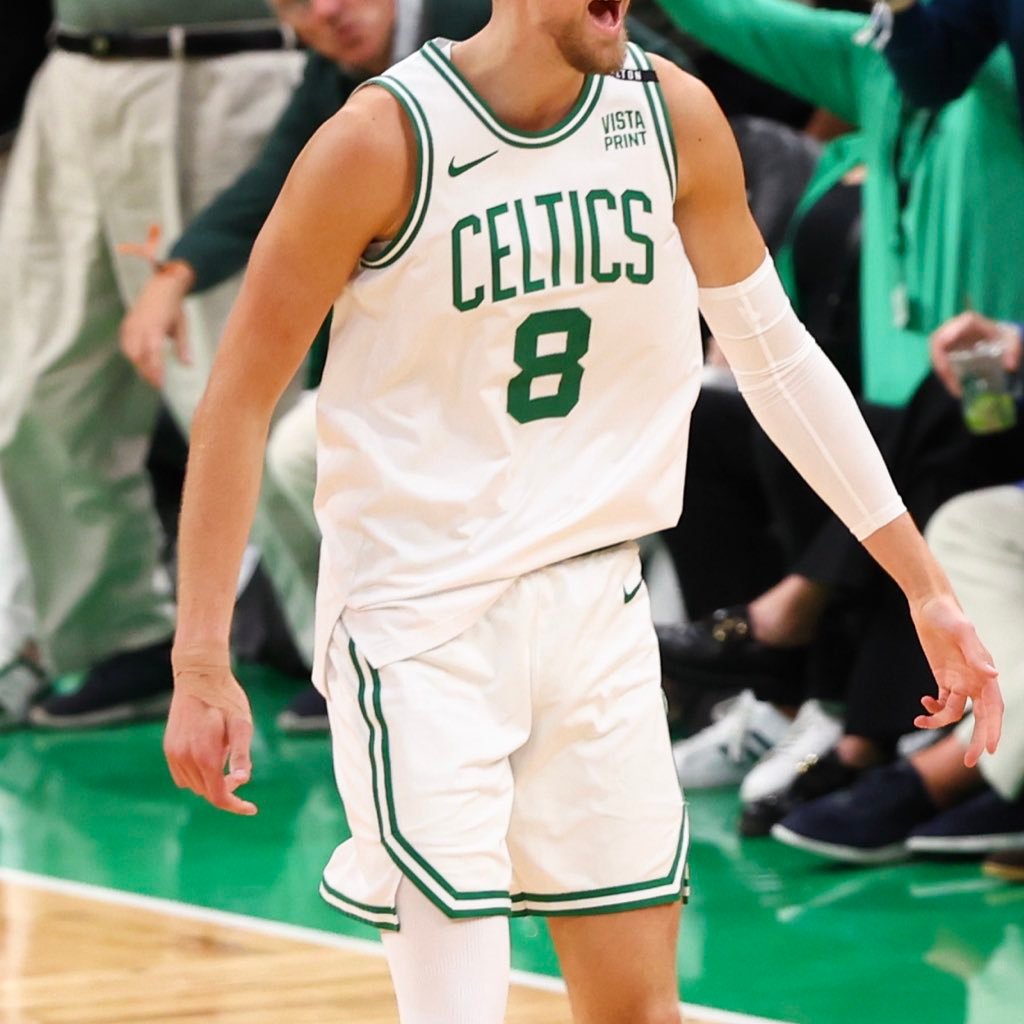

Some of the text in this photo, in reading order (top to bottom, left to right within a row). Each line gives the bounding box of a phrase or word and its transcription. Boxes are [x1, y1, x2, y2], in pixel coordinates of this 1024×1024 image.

[601, 110, 645, 134] VISTA
[604, 130, 648, 152] PRINT
[451, 189, 654, 312] CELTICS
[507, 307, 592, 425] 8
